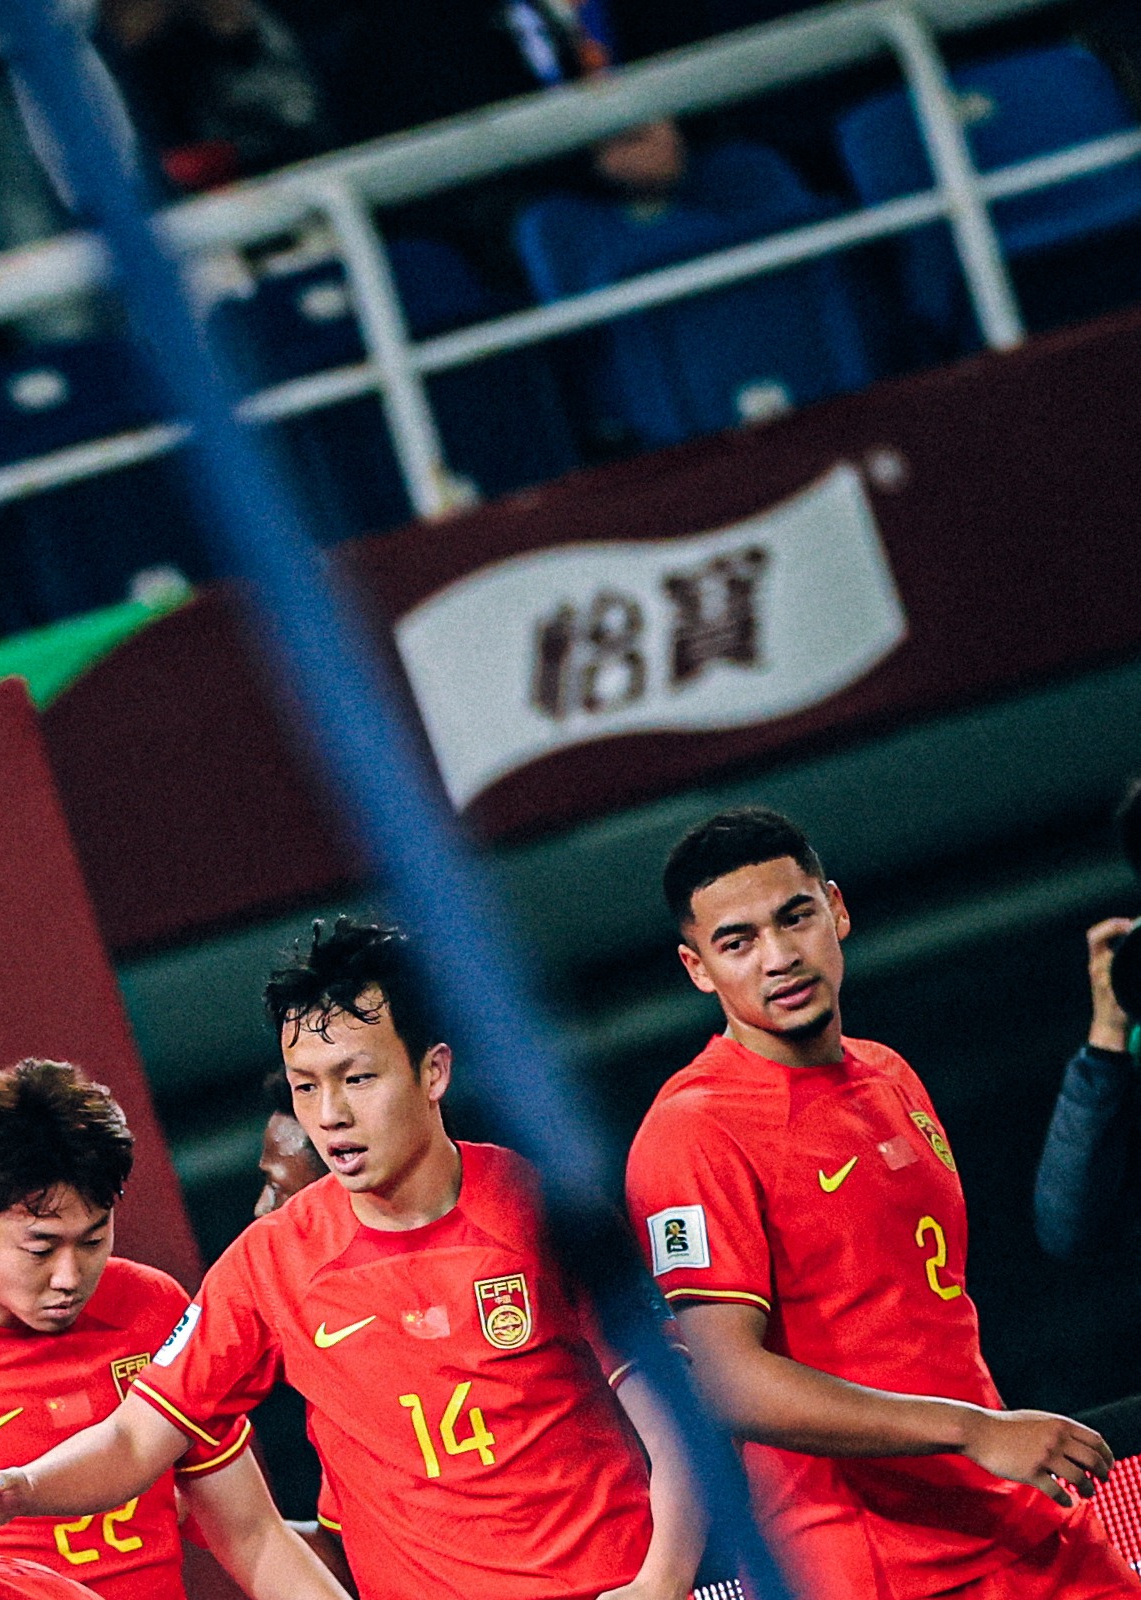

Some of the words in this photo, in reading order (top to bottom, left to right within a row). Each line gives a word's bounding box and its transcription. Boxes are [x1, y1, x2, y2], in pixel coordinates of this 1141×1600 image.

[479, 1279, 522, 1298] CFA
[915, 1216, 962, 1301] 2
[398, 1381, 496, 1479] 14
[53, 1497, 143, 1565] 22
